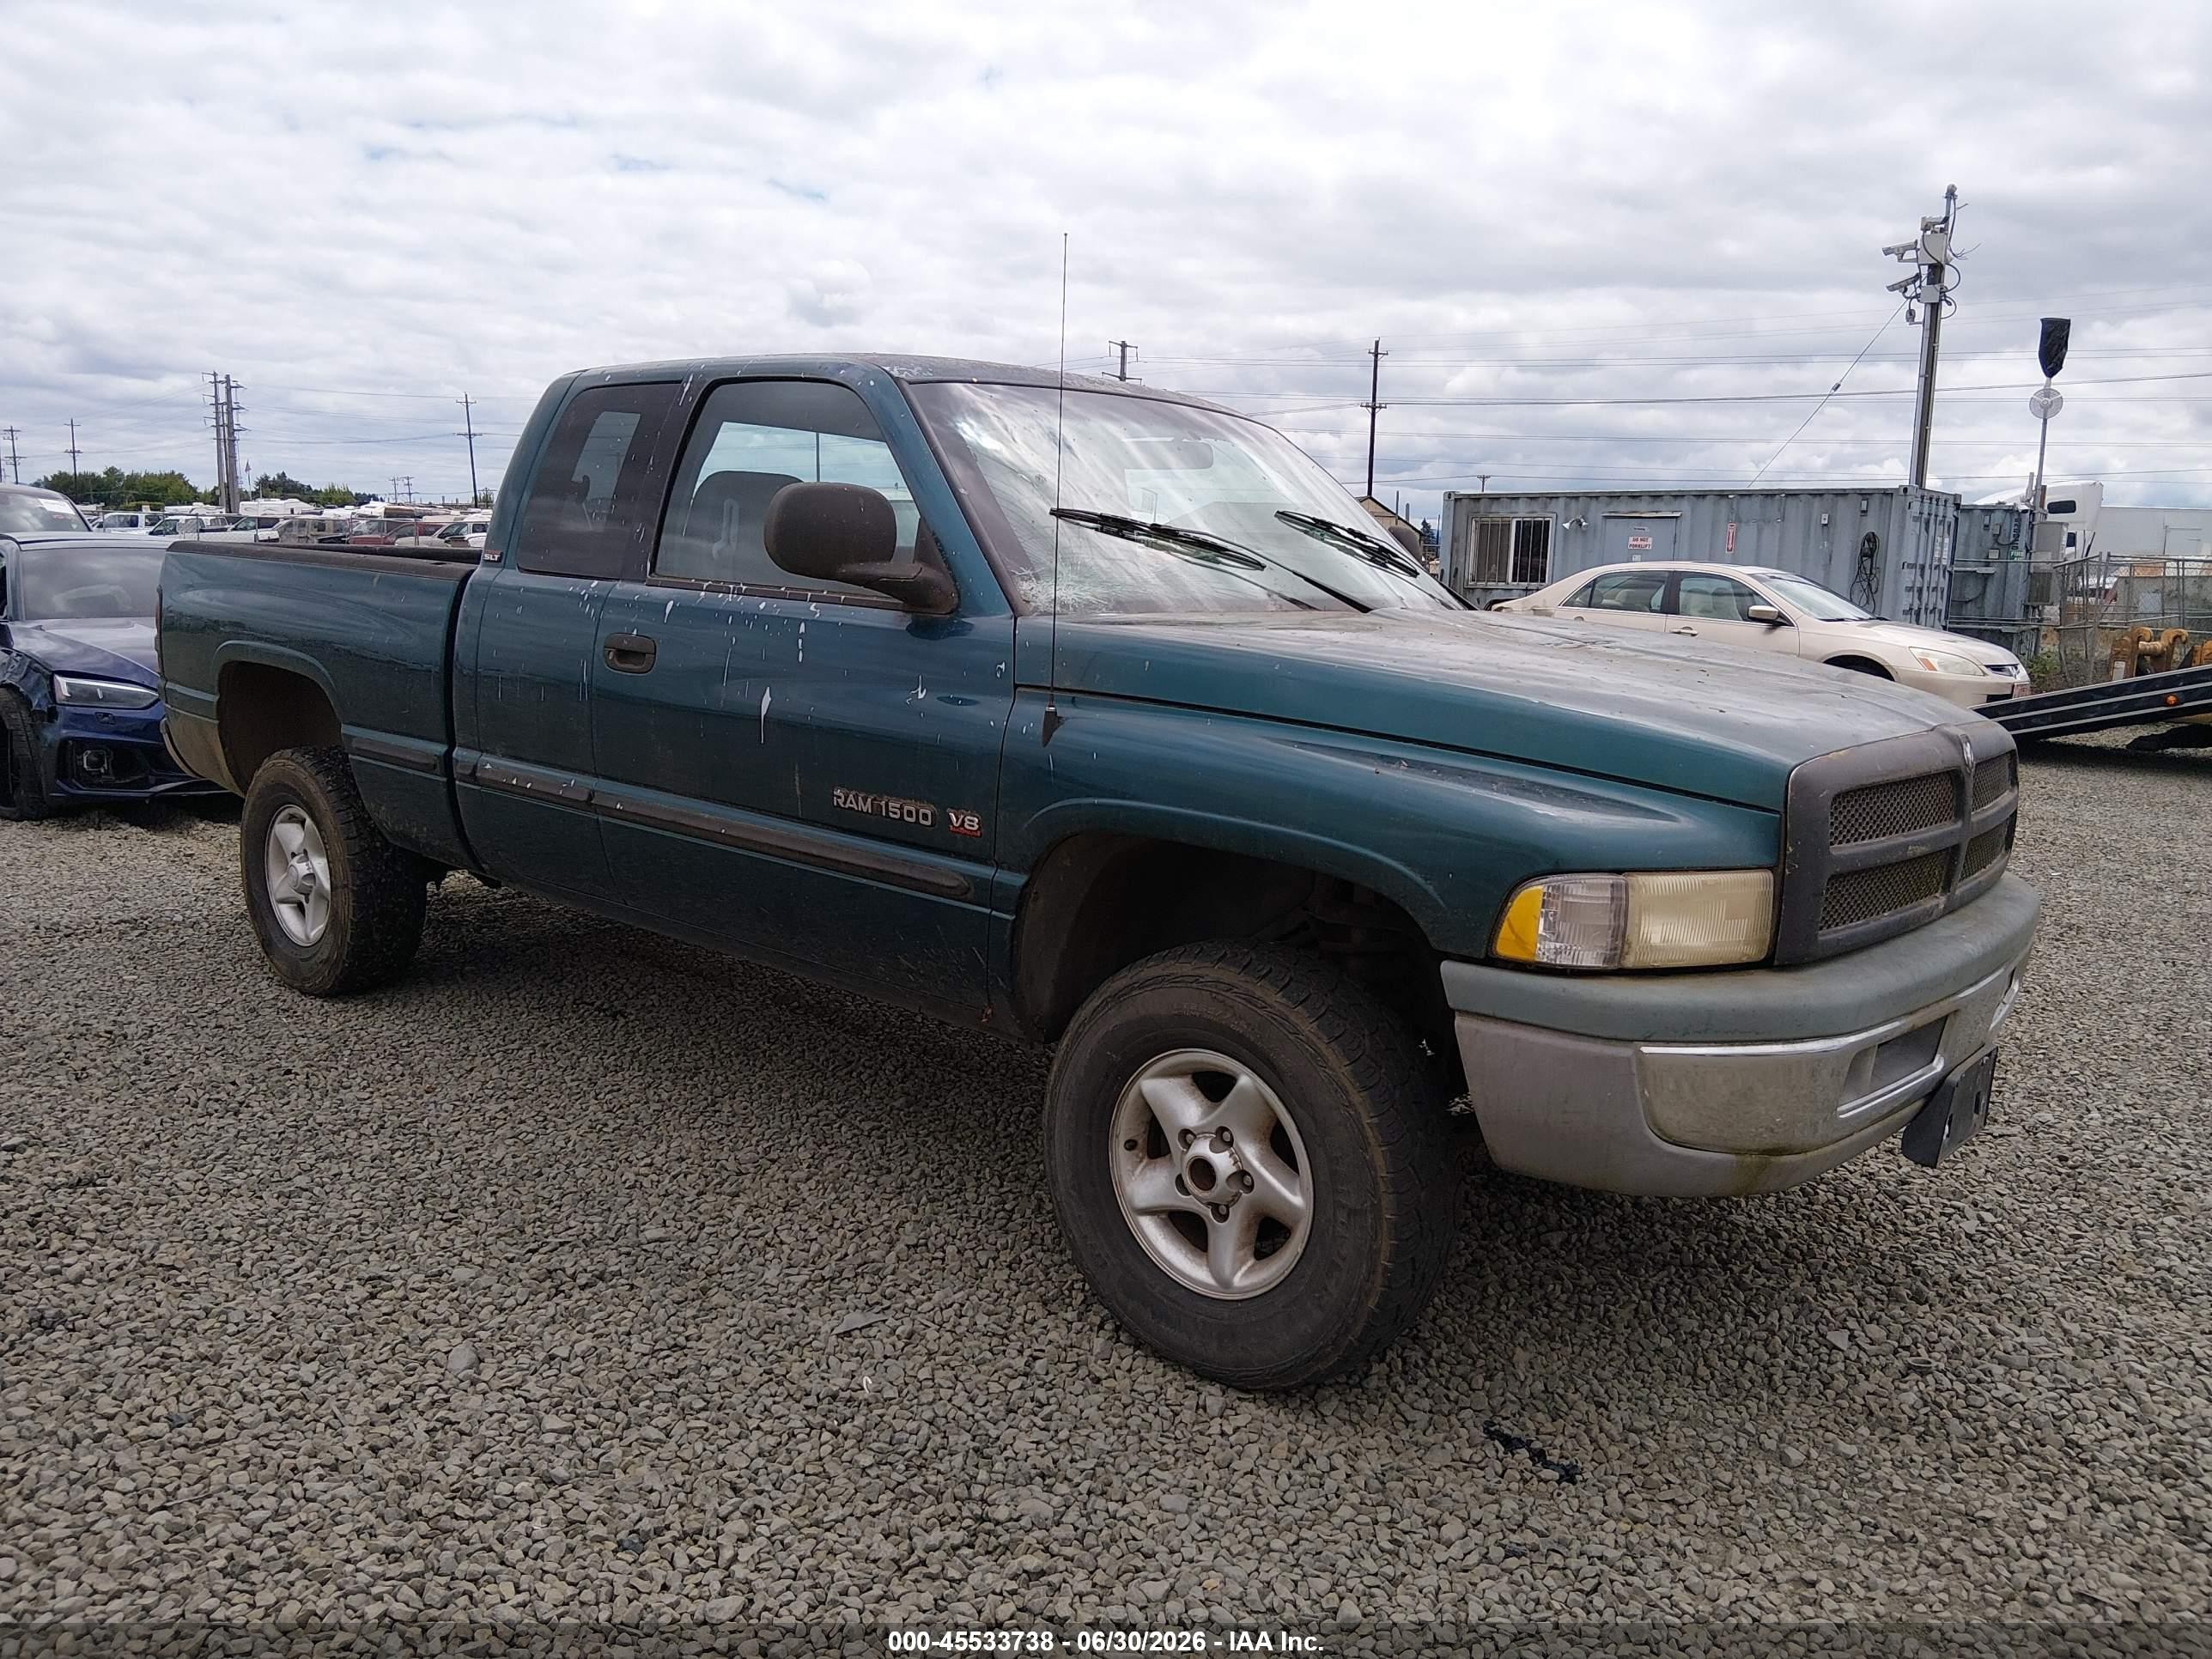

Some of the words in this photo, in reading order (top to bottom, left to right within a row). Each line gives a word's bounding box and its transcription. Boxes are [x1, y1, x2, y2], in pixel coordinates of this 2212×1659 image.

[483, 553, 501, 562] SLT
[833, 788, 872, 814] RAM
[874, 800, 932, 826] 1500
[949, 812, 980, 830] V8
